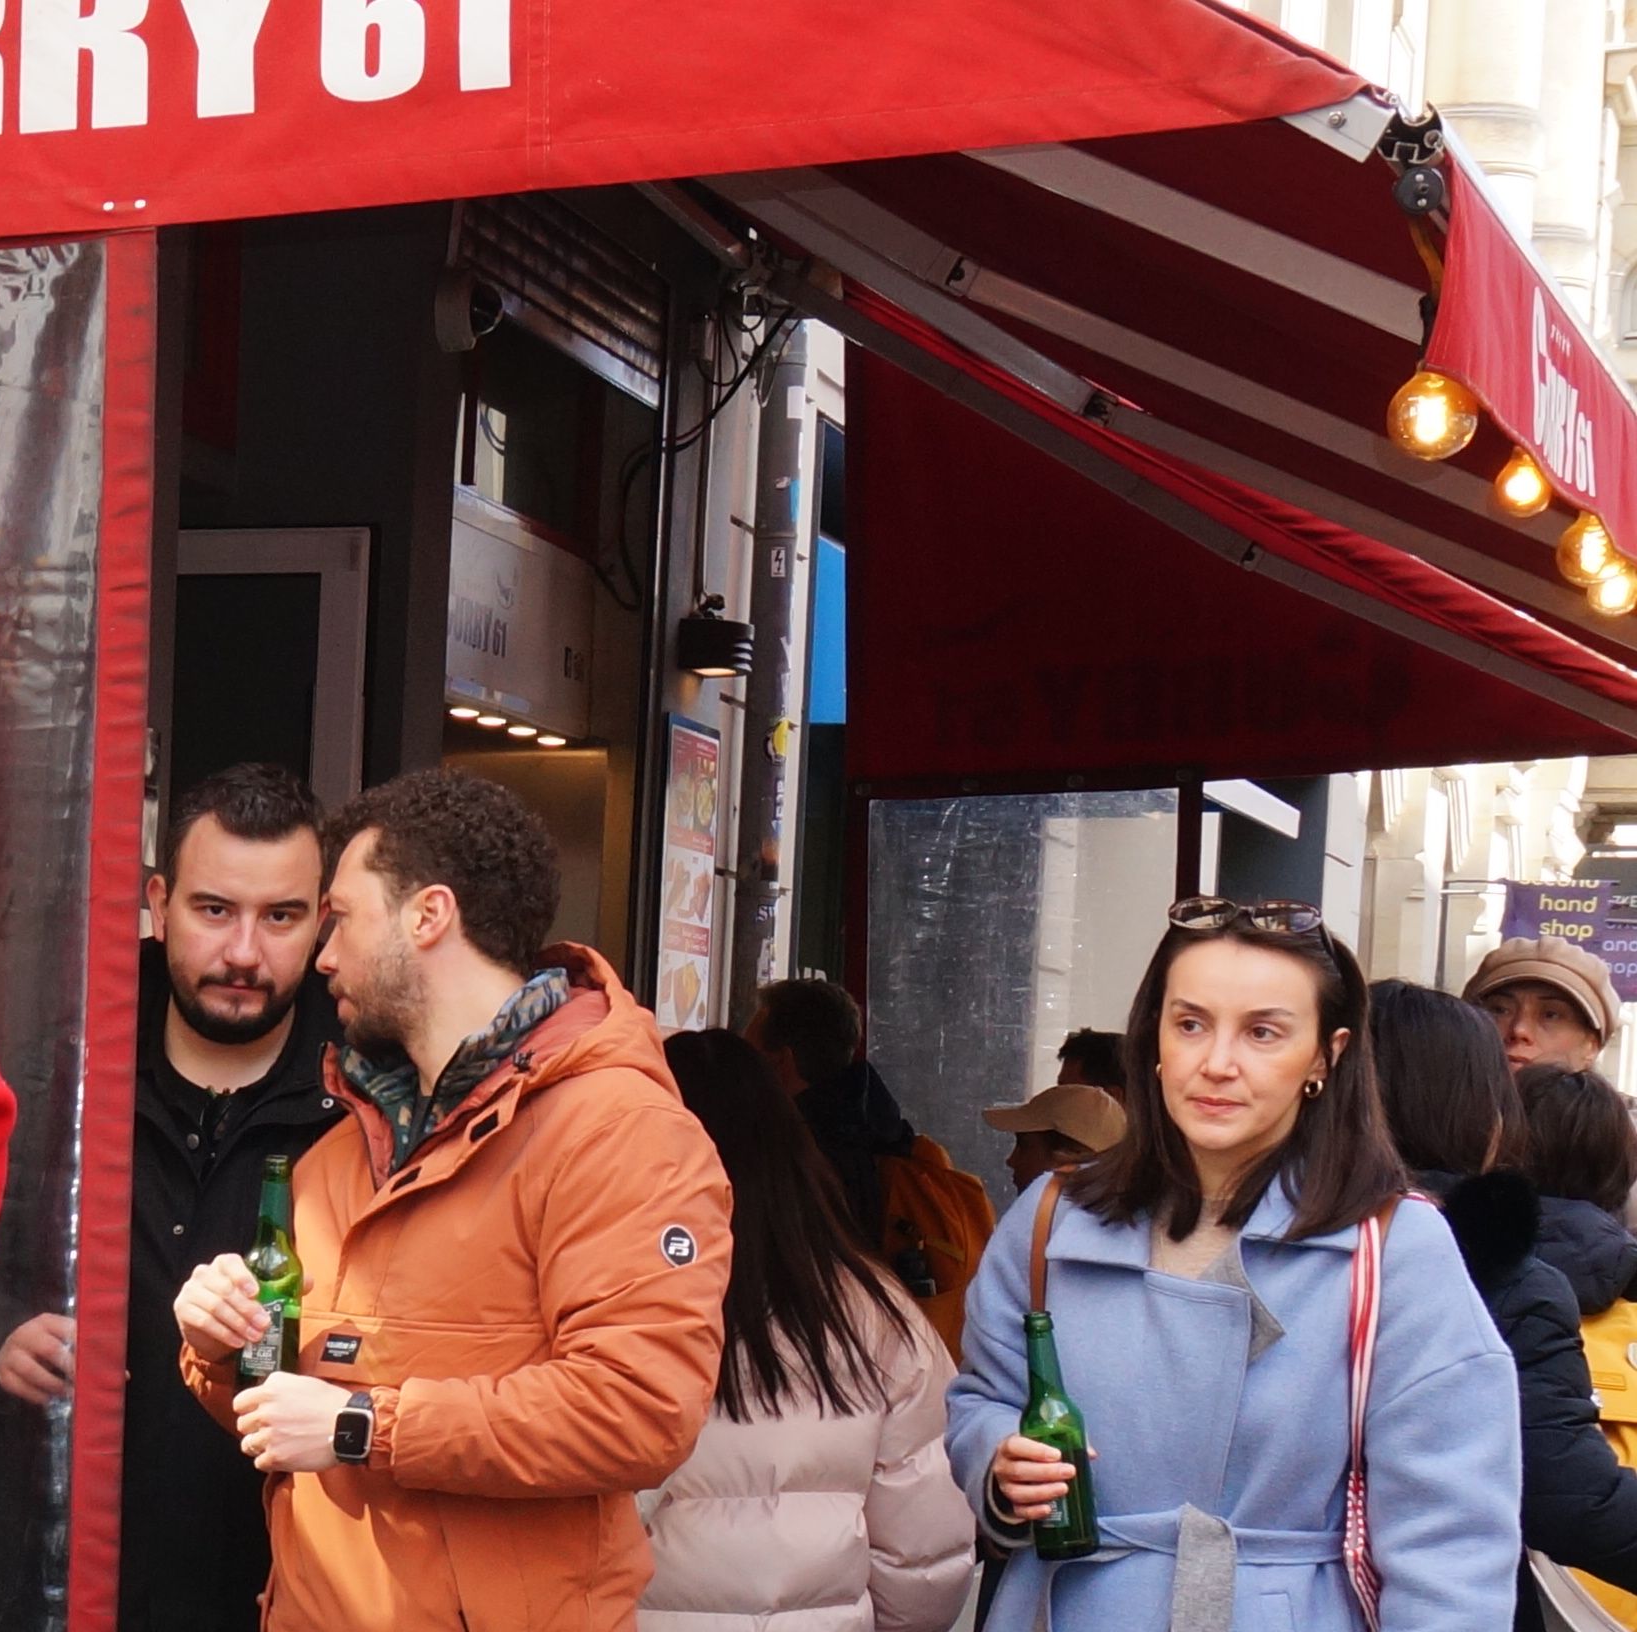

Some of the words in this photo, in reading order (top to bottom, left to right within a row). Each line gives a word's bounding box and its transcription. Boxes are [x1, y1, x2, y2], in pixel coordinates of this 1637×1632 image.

[1576, 412, 1596, 497] 61
[1540, 894, 1598, 913] hand
[1539, 919, 1593, 941] shop
